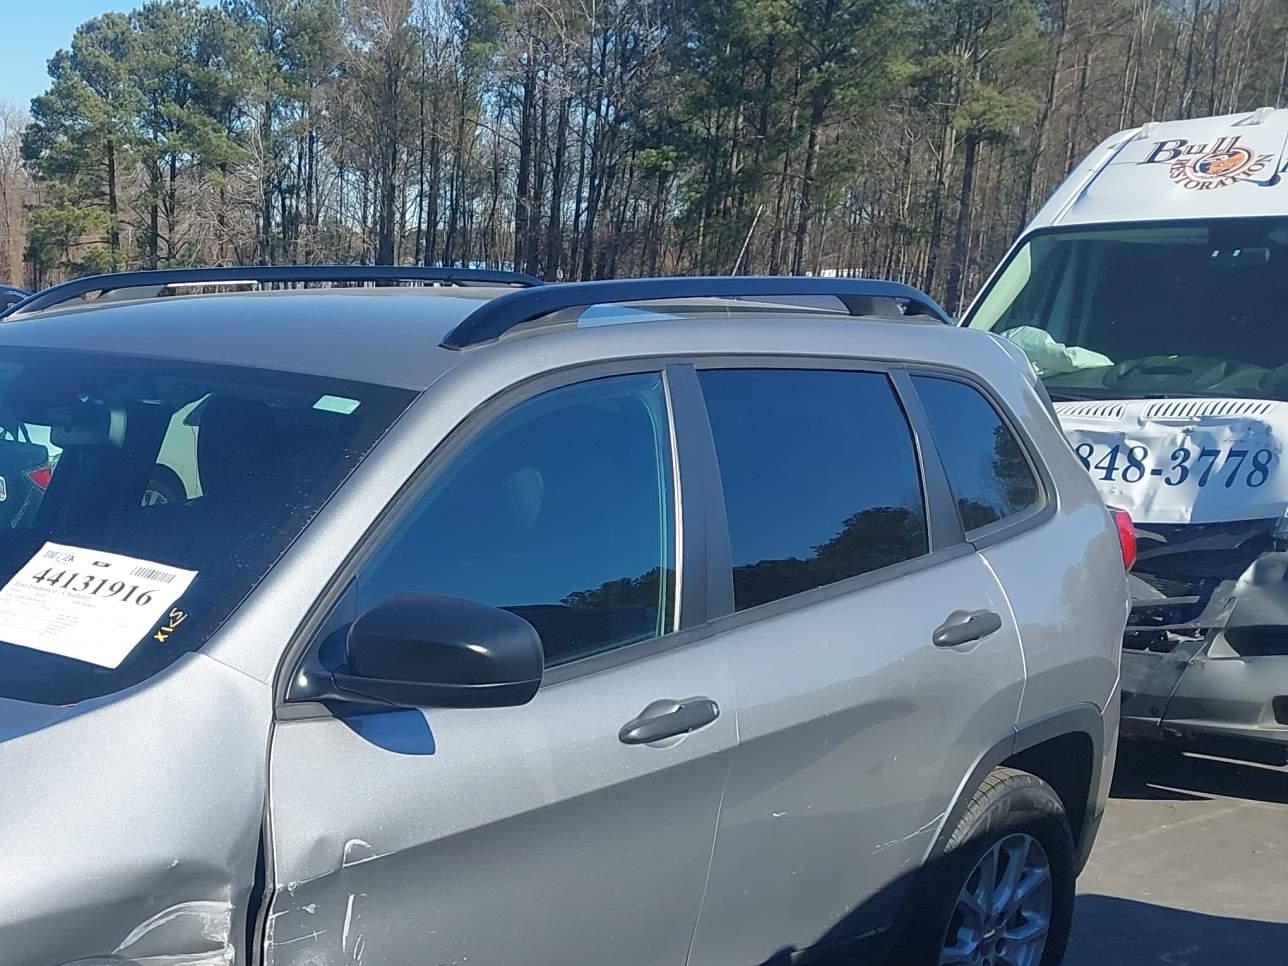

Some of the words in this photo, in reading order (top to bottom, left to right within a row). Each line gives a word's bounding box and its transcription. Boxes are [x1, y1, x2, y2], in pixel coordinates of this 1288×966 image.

[1136, 135, 1242, 166] Bull
[1168, 153, 1276, 191] RESTORATION
[1075, 442, 1273, 489] 848-3778
[31, 567, 161, 607] 44131916
